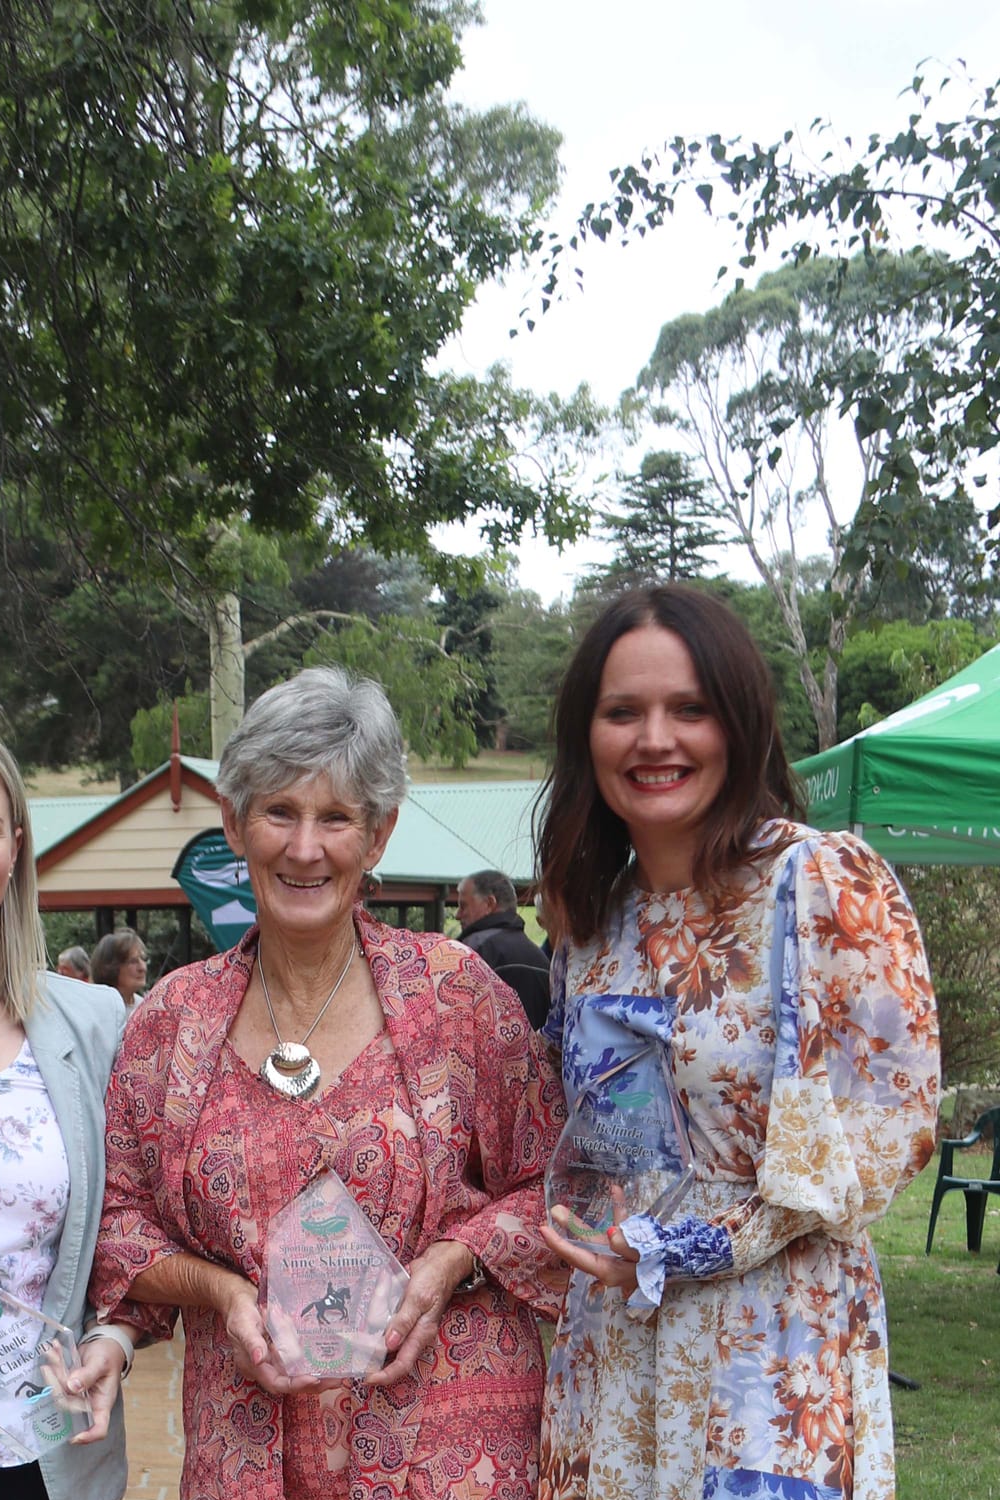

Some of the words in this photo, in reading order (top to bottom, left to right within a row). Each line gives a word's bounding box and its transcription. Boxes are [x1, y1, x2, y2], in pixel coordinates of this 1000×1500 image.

[594, 1121, 644, 1139] Belinda
[281, 1258, 315, 1268] Anne
[319, 1256, 373, 1267] Skinner
